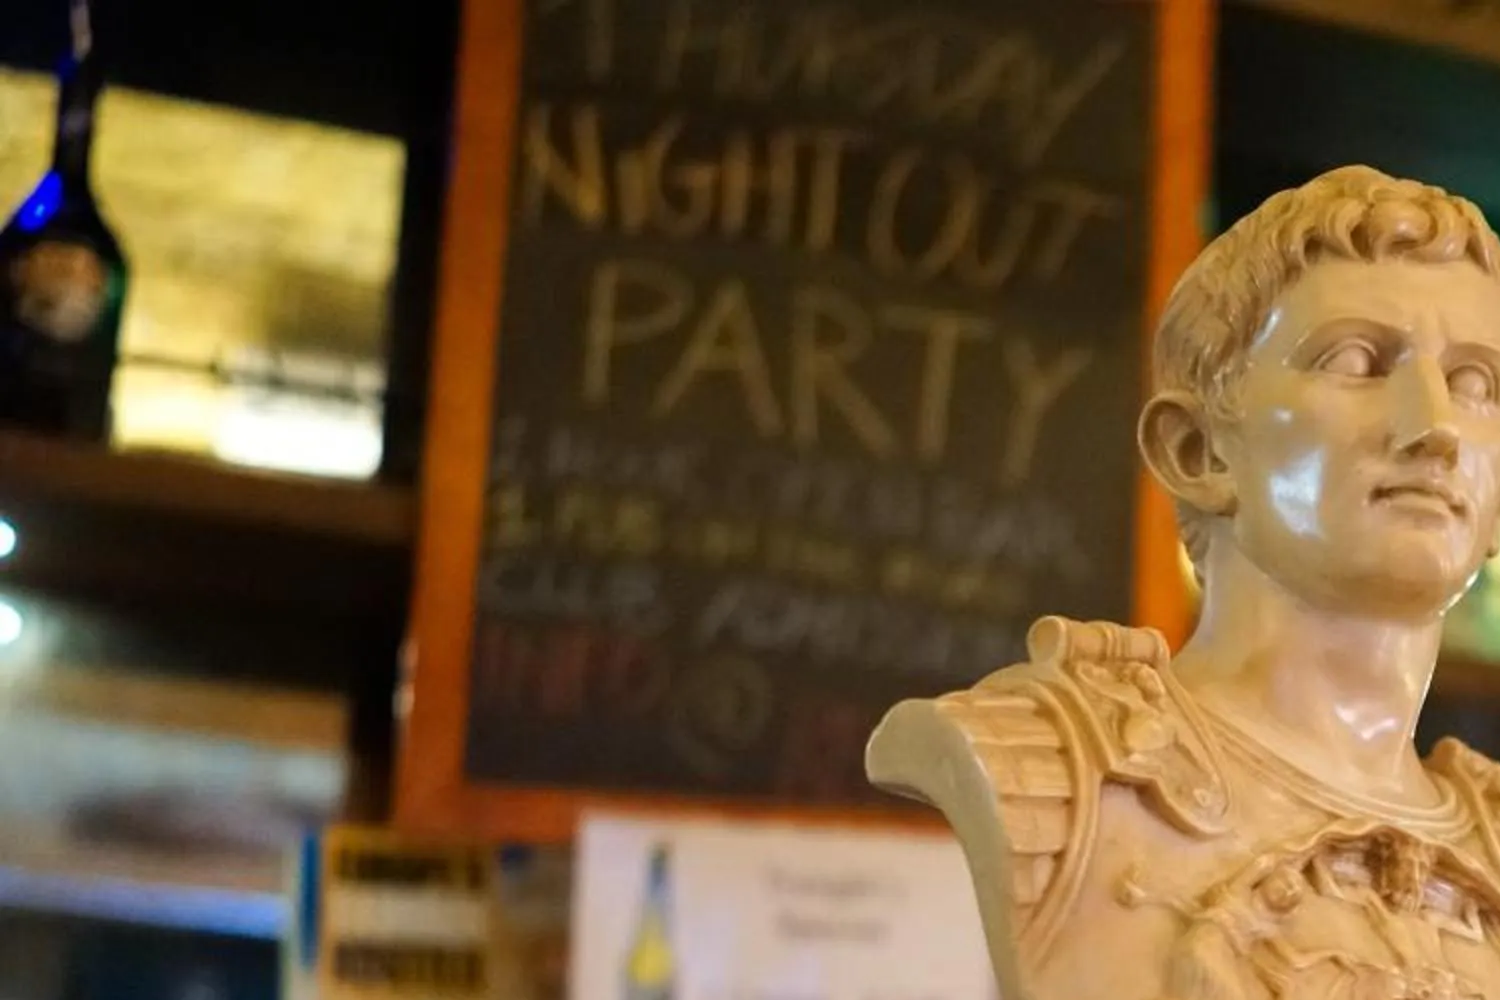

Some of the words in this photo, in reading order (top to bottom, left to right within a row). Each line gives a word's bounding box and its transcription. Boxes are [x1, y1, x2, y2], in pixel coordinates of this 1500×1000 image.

[522, 102, 866, 252] NIGHT
[864, 144, 1124, 290] OUT
[580, 258, 1093, 488] PARTY
